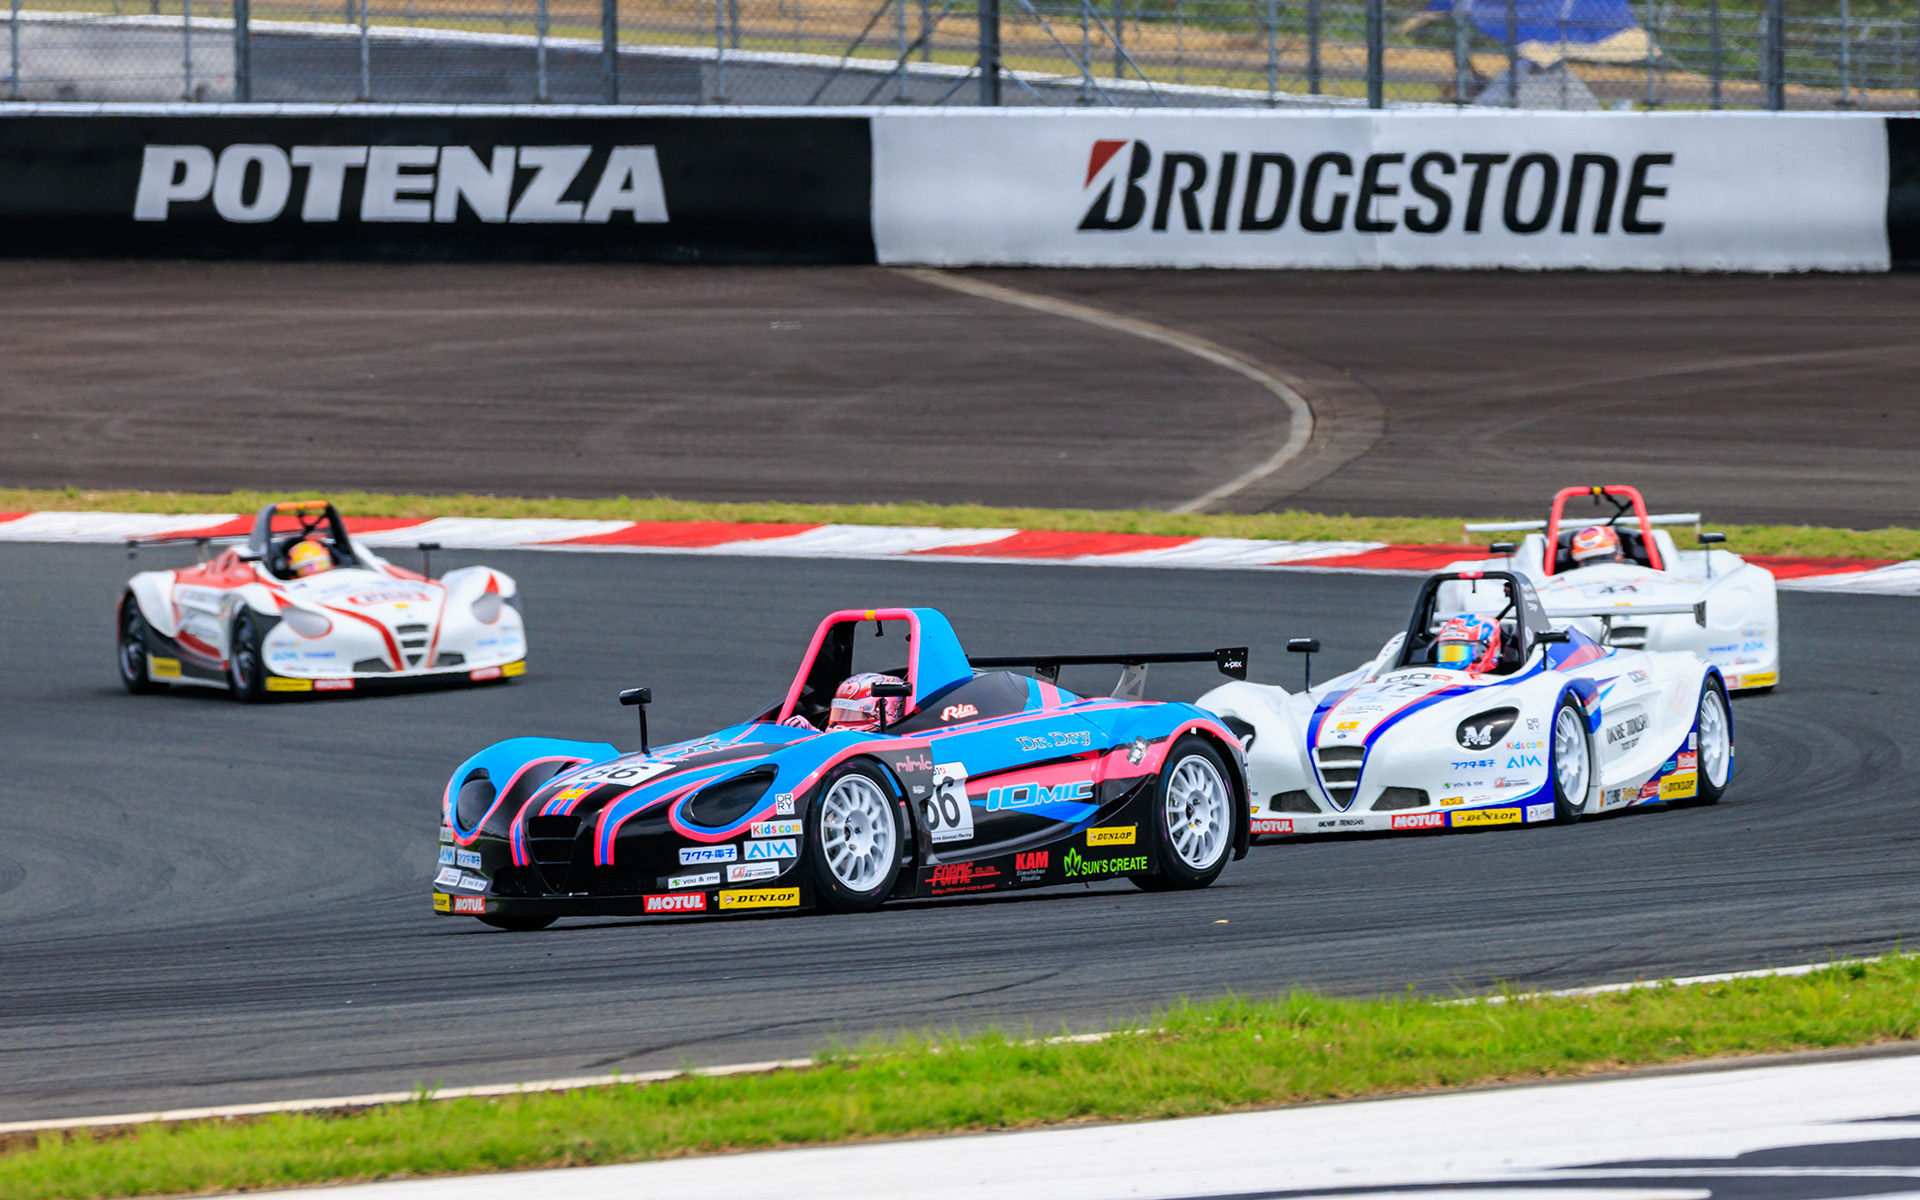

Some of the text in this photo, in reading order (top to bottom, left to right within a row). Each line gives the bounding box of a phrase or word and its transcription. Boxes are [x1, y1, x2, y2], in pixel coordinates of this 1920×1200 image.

[133, 144, 669, 224] POTENZA
[1076, 139, 1675, 235] BRIDGESTONE
[1506, 741, 1525, 750] Kids
[1506, 755, 1543, 769] AIM
[1394, 814, 1443, 828] MOTUL
[1466, 812, 1516, 822] DUNLOP
[752, 824, 801, 835] Kids com
[1251, 821, 1292, 832] MOTUL
[1096, 832, 1132, 840] DUNLOP
[681, 848, 735, 861] フクタ電子
[747, 841, 794, 858] AIM
[1015, 851, 1049, 870] KAM
[1081, 856, 1148, 875] SUN'S CREATE
[454, 897, 485, 911] MOTUL
[647, 895, 703, 910] MOTUL
[737, 893, 795, 903] DUNLOP
